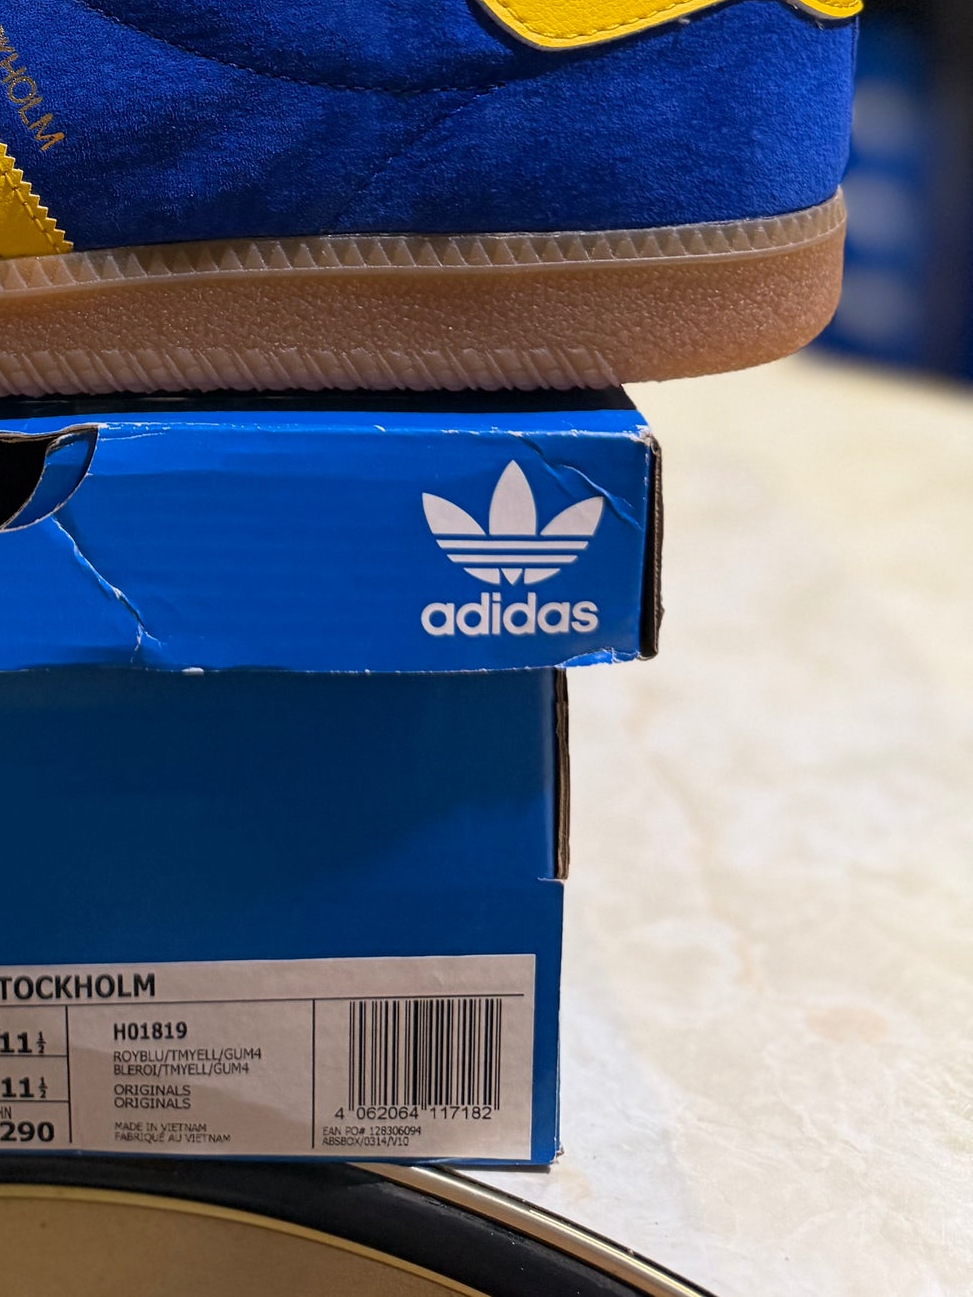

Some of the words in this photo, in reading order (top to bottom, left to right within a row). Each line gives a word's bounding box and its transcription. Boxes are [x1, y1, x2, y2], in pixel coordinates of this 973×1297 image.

[421, 592, 599, 636] adidas
[113, 1021, 188, 1040] H01819
[113, 1048, 262, 1063] ROYBLU/TMYELL/GUM4
[113, 1062, 249, 1077] BLEROI/TMYELL/GUM4
[113, 1084, 192, 1097] ORIGINALS
[113, 1097, 192, 1110] ORIGINALS
[335, 1107, 345, 1120] 4
[356, 1107, 419, 1120] 062064
[431, 1106, 493, 1120] 117182
[0, 1121, 55, 1143] 290
[114, 1122, 143, 1132] MADE
[146, 1122, 158, 1132] IN
[160, 1122, 208, 1133] VIETNAM
[322, 1126, 342, 1136] EAN
[345, 1126, 366, 1136] PO#
[369, 1126, 422, 1136] 128306094
[168, 1133, 182, 1143] AU
[184, 1133, 232, 1144] VIETNAM
